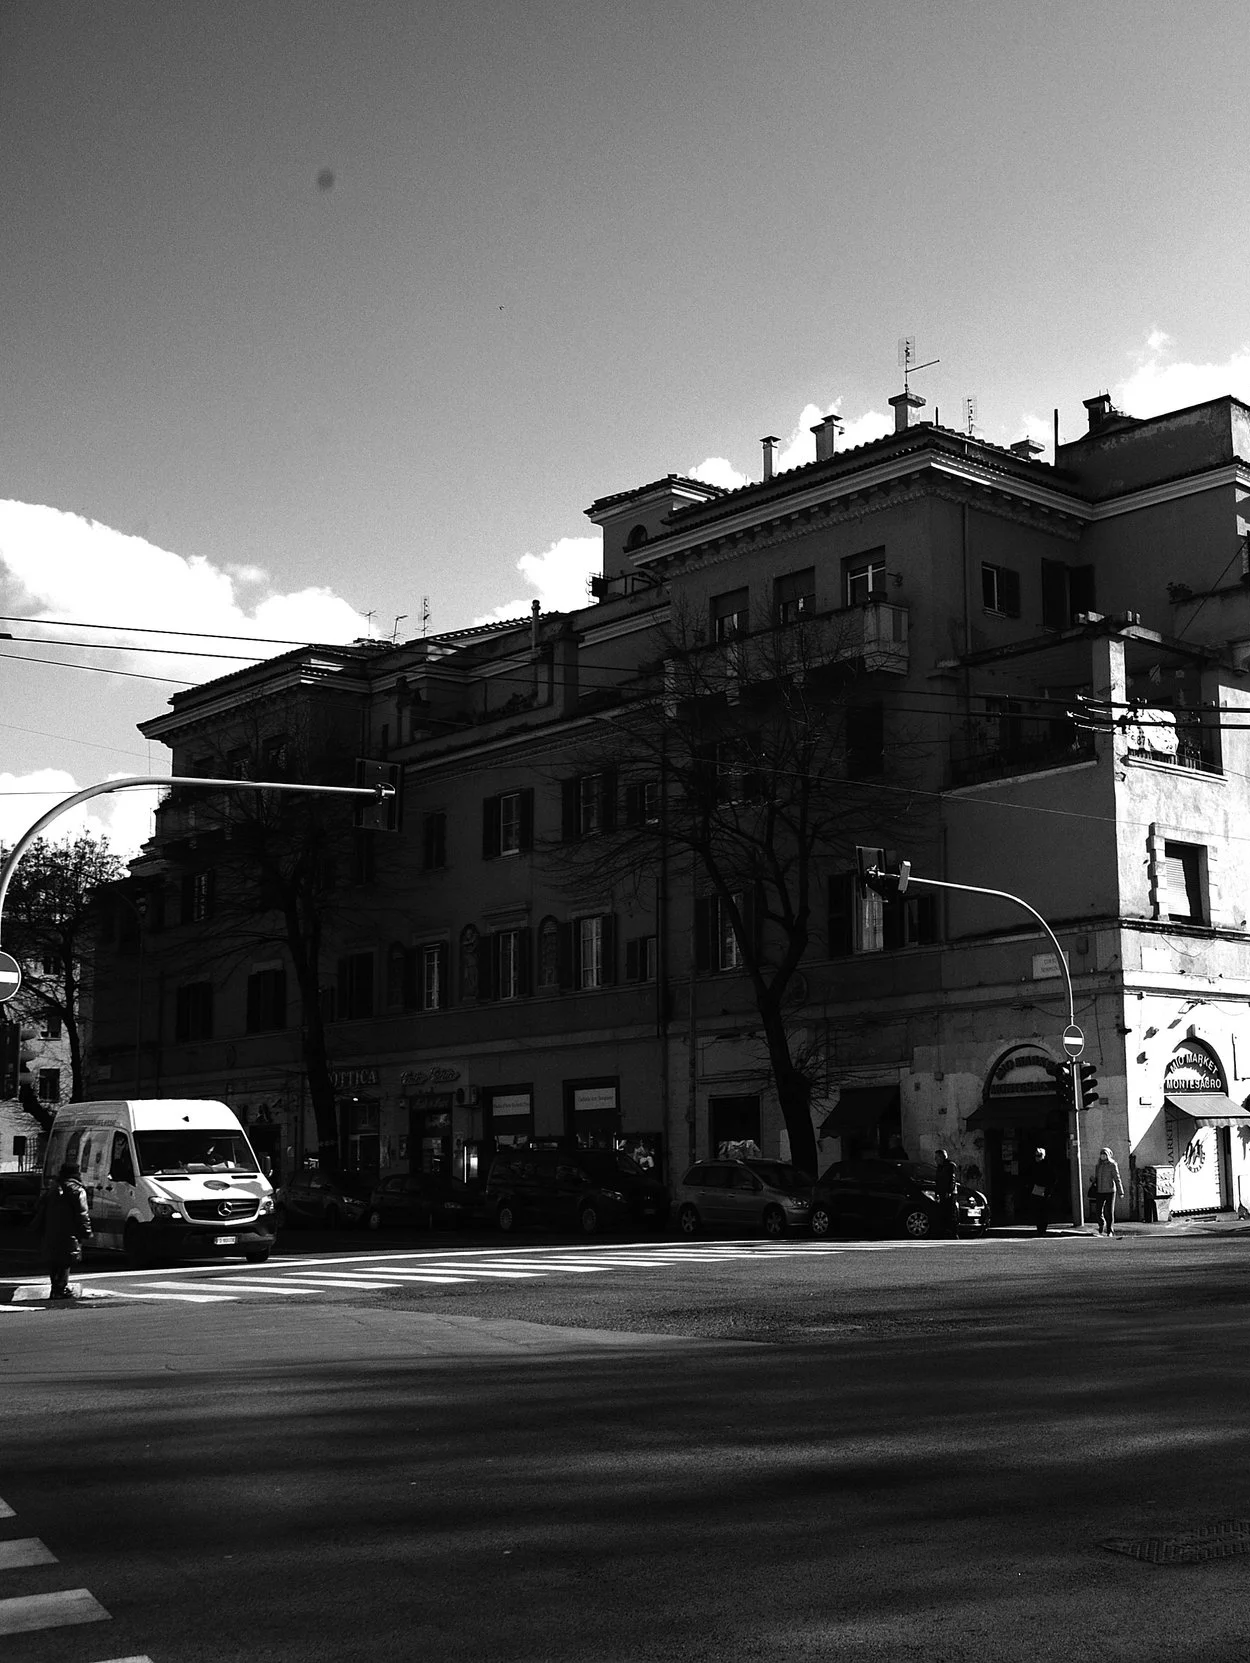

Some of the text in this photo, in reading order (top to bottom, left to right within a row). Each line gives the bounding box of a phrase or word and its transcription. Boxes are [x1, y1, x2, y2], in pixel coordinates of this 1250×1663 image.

[1169, 1053, 1218, 1074] MIO MARKET
[1166, 1078, 1222, 1089] MONTESACRO
